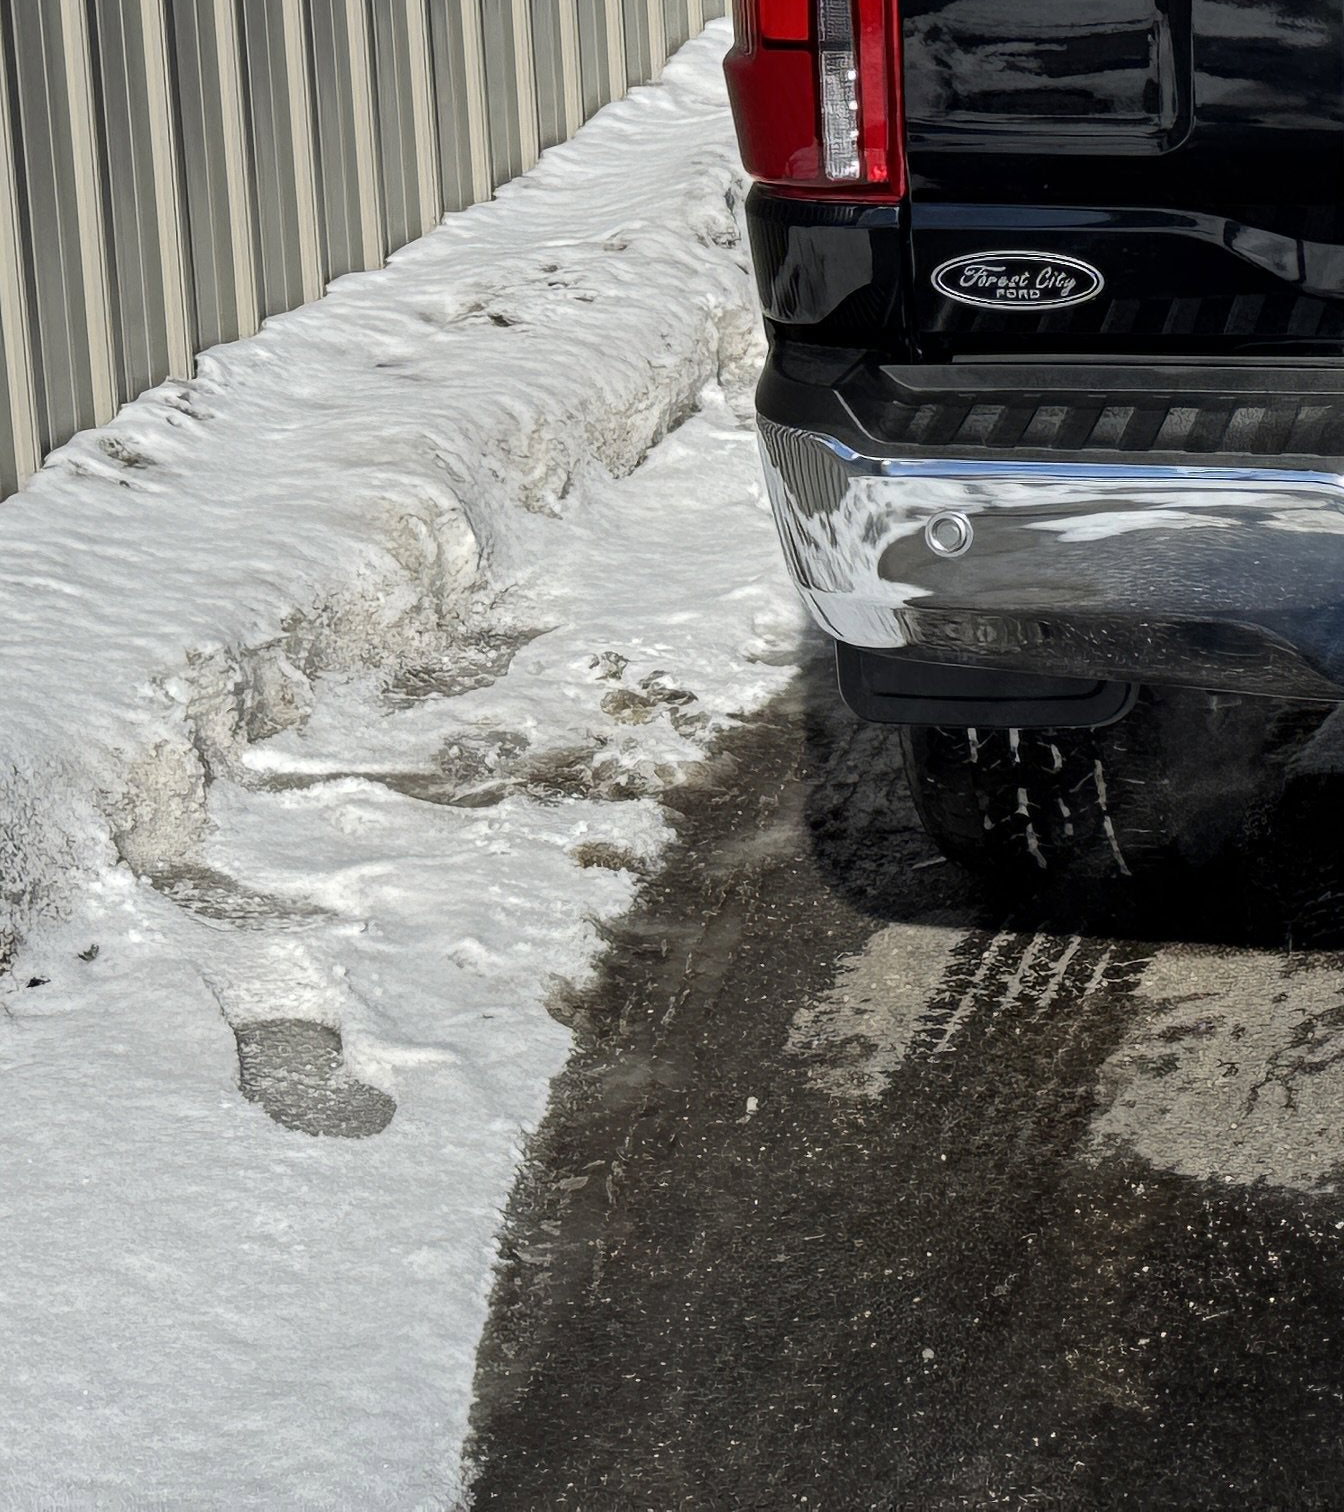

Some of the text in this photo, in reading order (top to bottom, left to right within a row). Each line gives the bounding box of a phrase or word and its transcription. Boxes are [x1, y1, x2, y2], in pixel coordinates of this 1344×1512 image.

[959, 264, 1077, 297] Forest City
[996, 289, 1040, 299] FORD
